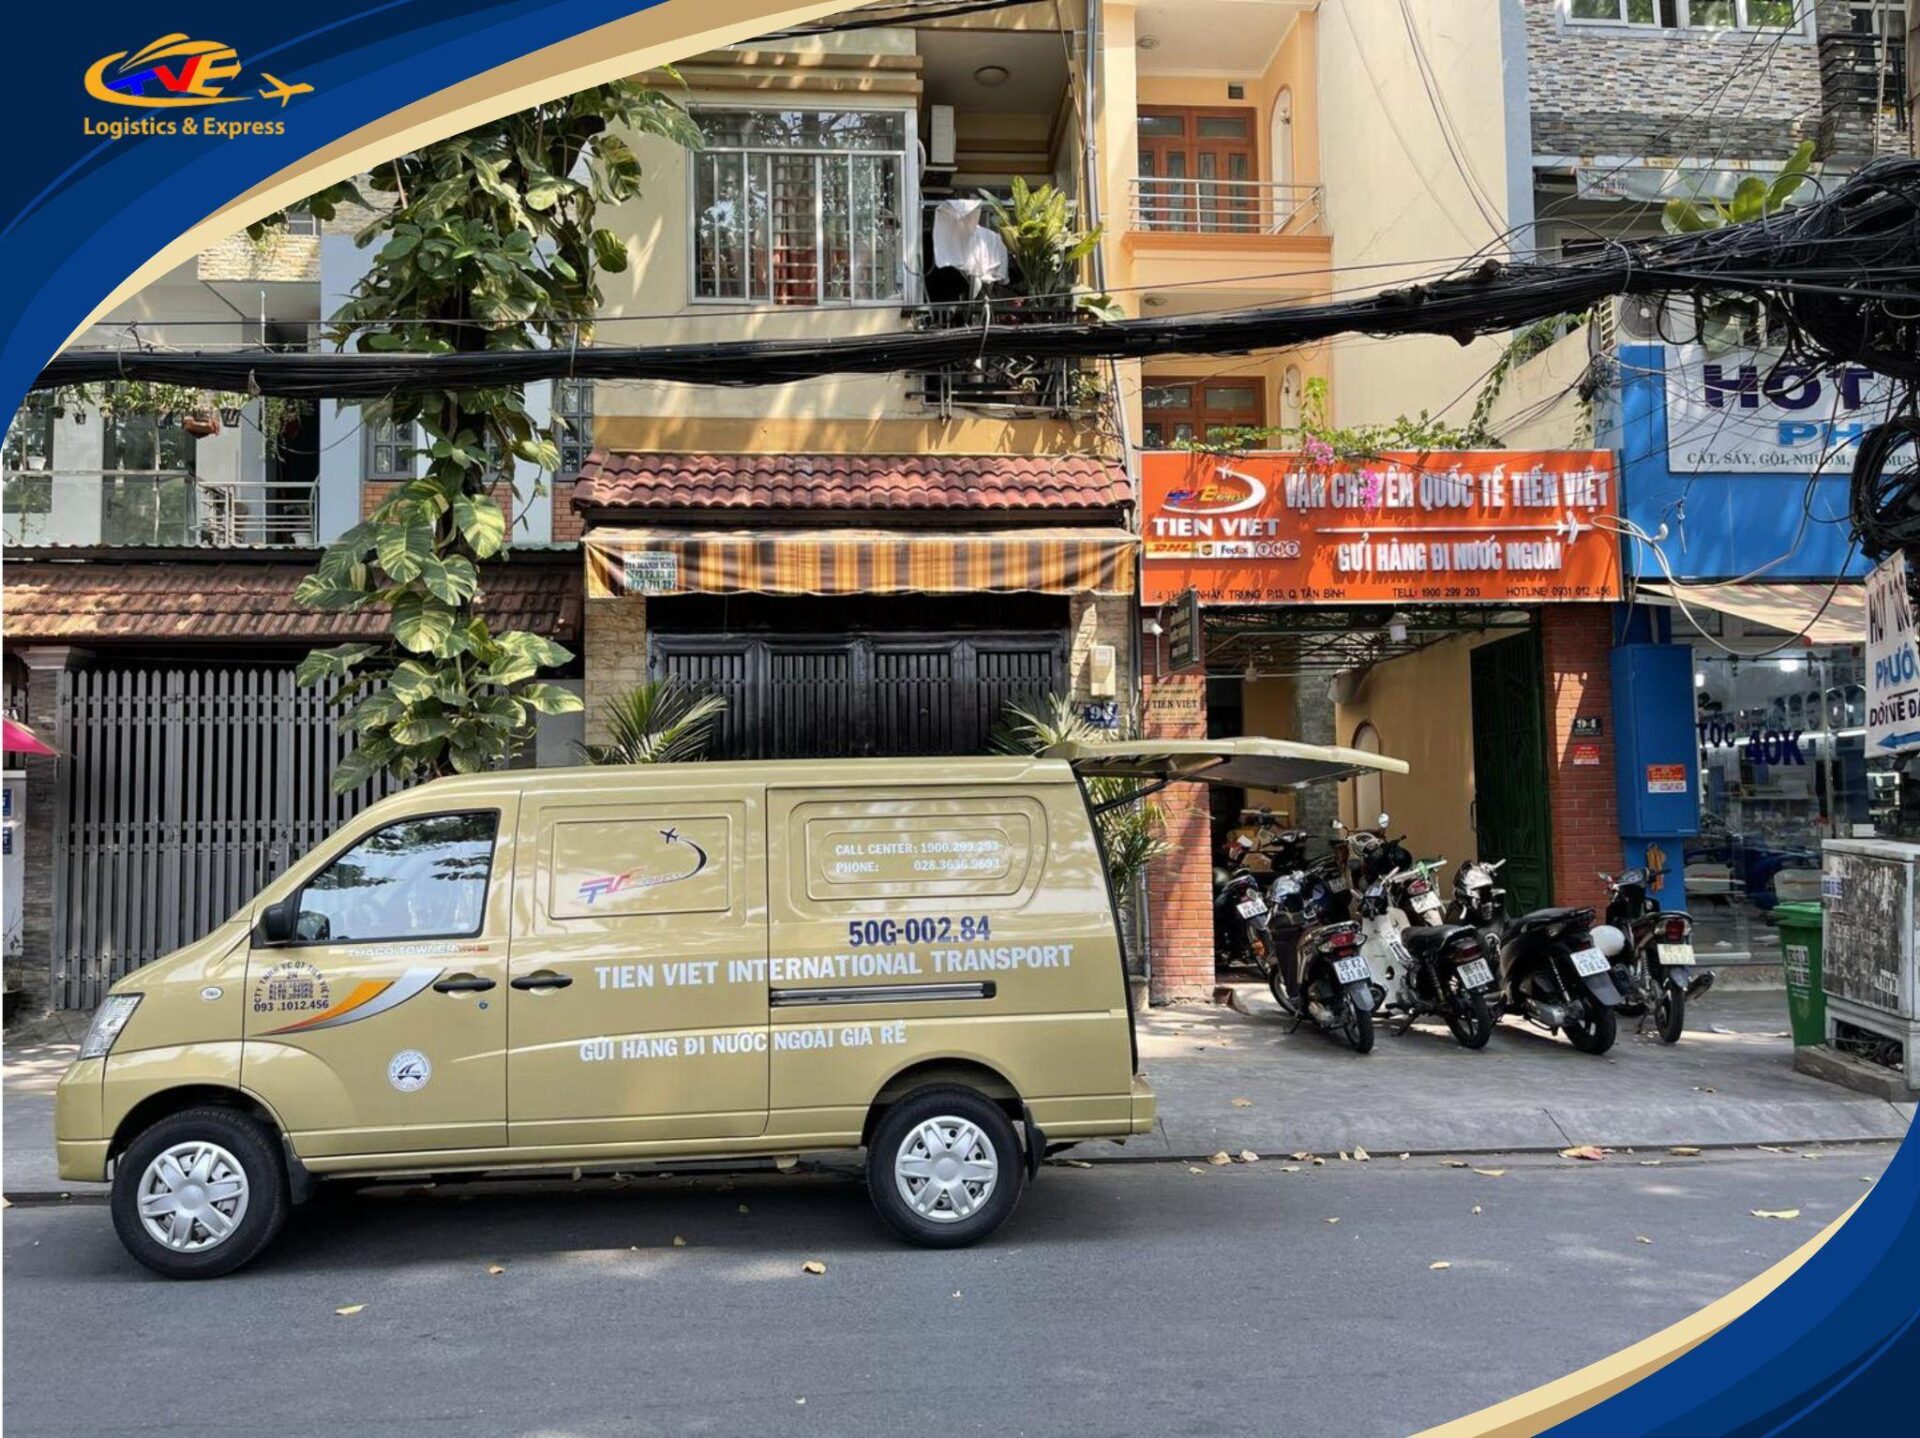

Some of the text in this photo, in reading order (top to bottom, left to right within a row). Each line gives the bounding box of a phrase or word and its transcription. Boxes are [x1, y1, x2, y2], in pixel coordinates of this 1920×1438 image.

[1284, 465, 1327, 513] VẬN
[1419, 462, 1474, 511] QUỐC
[1479, 463, 1506, 507] TẾ
[1511, 463, 1560, 507] TIẾN
[1563, 464, 1610, 512] VIỆT
[1153, 518, 1280, 537] TIEN VIET
[1153, 543, 1191, 552] DHL
[1220, 545, 1249, 555] FedEx
[1454, 534, 1502, 570] NƯỚC
[1506, 536, 1562, 570] NGOÀI
[835, 843, 864, 855] CALL
[868, 842, 918, 855] CENTER:
[835, 862, 879, 873] PHONE:
[849, 915, 991, 947] 50G-002.84
[594, 944, 1074, 990] TIEN VIET INTERNATIONAL TRANSPORT
[254, 1002, 274, 1012] 093
